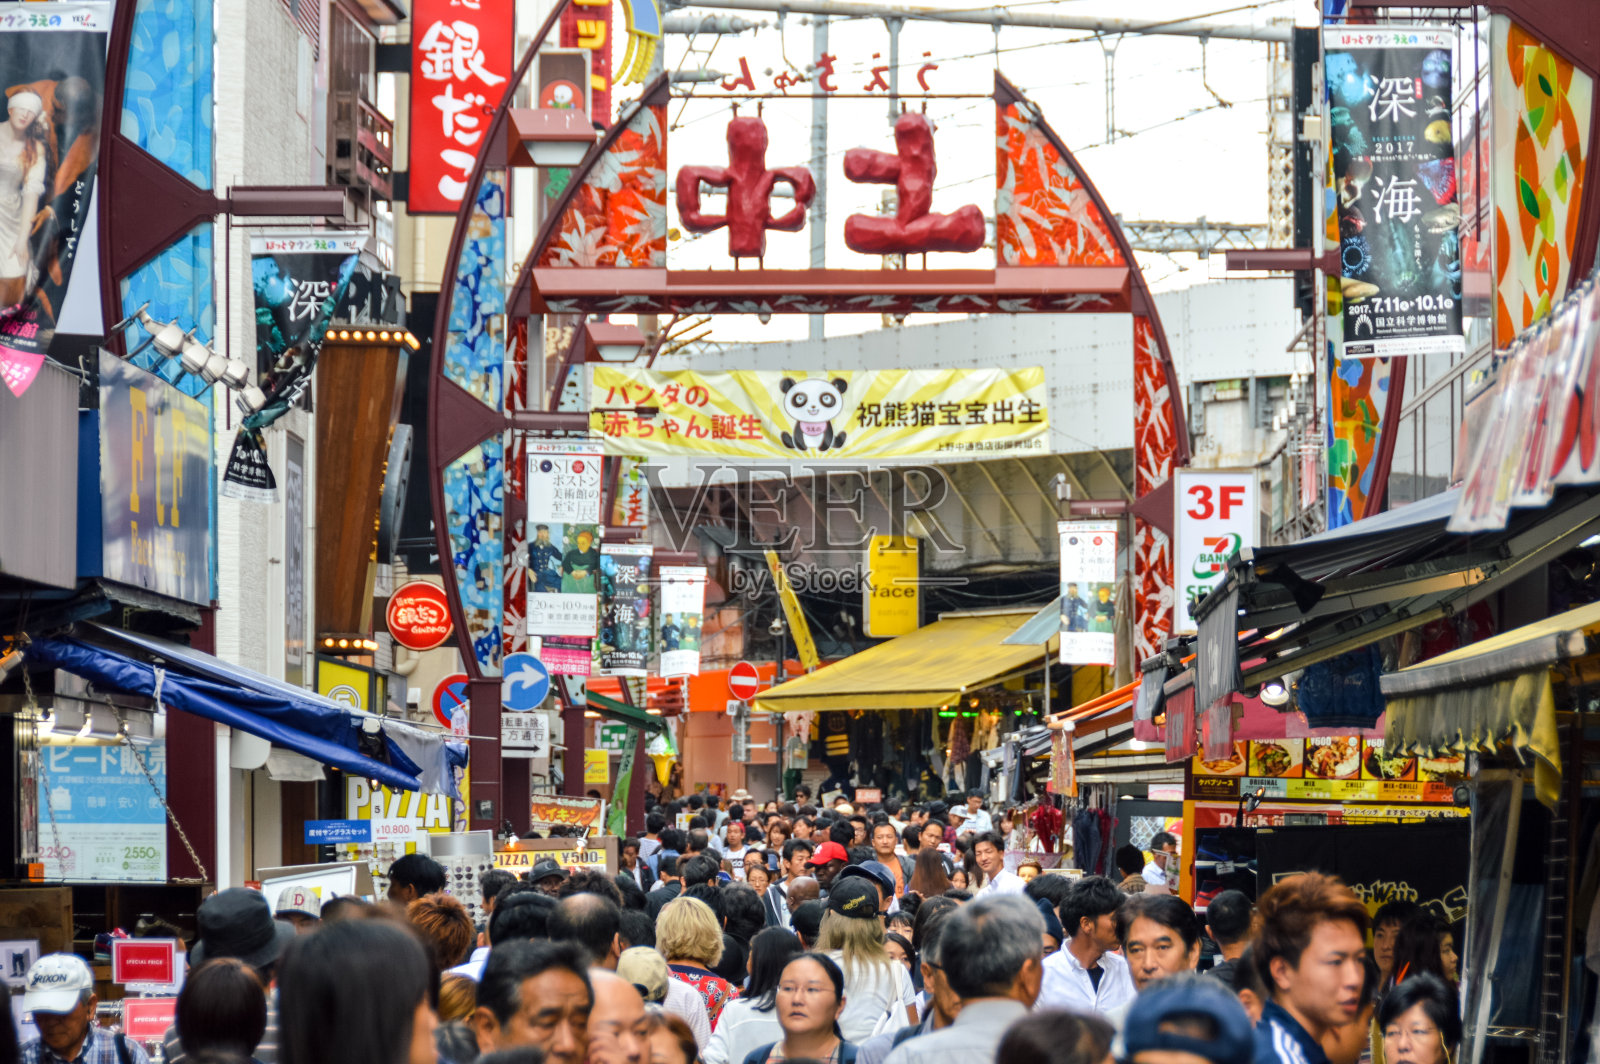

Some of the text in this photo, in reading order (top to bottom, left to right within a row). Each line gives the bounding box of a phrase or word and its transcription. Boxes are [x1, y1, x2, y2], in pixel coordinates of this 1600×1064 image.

[1367, 75, 1417, 123] 深
[418, 20, 506, 201] 銀だこ
[1375, 142, 1414, 153] 2017
[1370, 175, 1422, 224] 海
[288, 277, 330, 322] 深
[1375, 314, 1447, 328] 国立科学博物館
[604, 382, 710, 408] パンダの
[857, 399, 1043, 428] 祝熊猫宝宝出生
[603, 411, 763, 441] 赤ちゃん誕生
[553, 475, 599, 487] ボストン
[553, 488, 599, 500] 美術館の
[1187, 485, 1245, 520] 3F
[1200, 553, 1230, 563] BANK
[615, 564, 637, 584] 深
[873, 583, 916, 598] face
[397, 605, 438, 625] 銀だこ
[613, 603, 635, 624] 海
[1249, 778, 1278, 786] ORIGINAL
[293, 893, 305, 906] D
[31, 973, 67, 986] SRIXON
